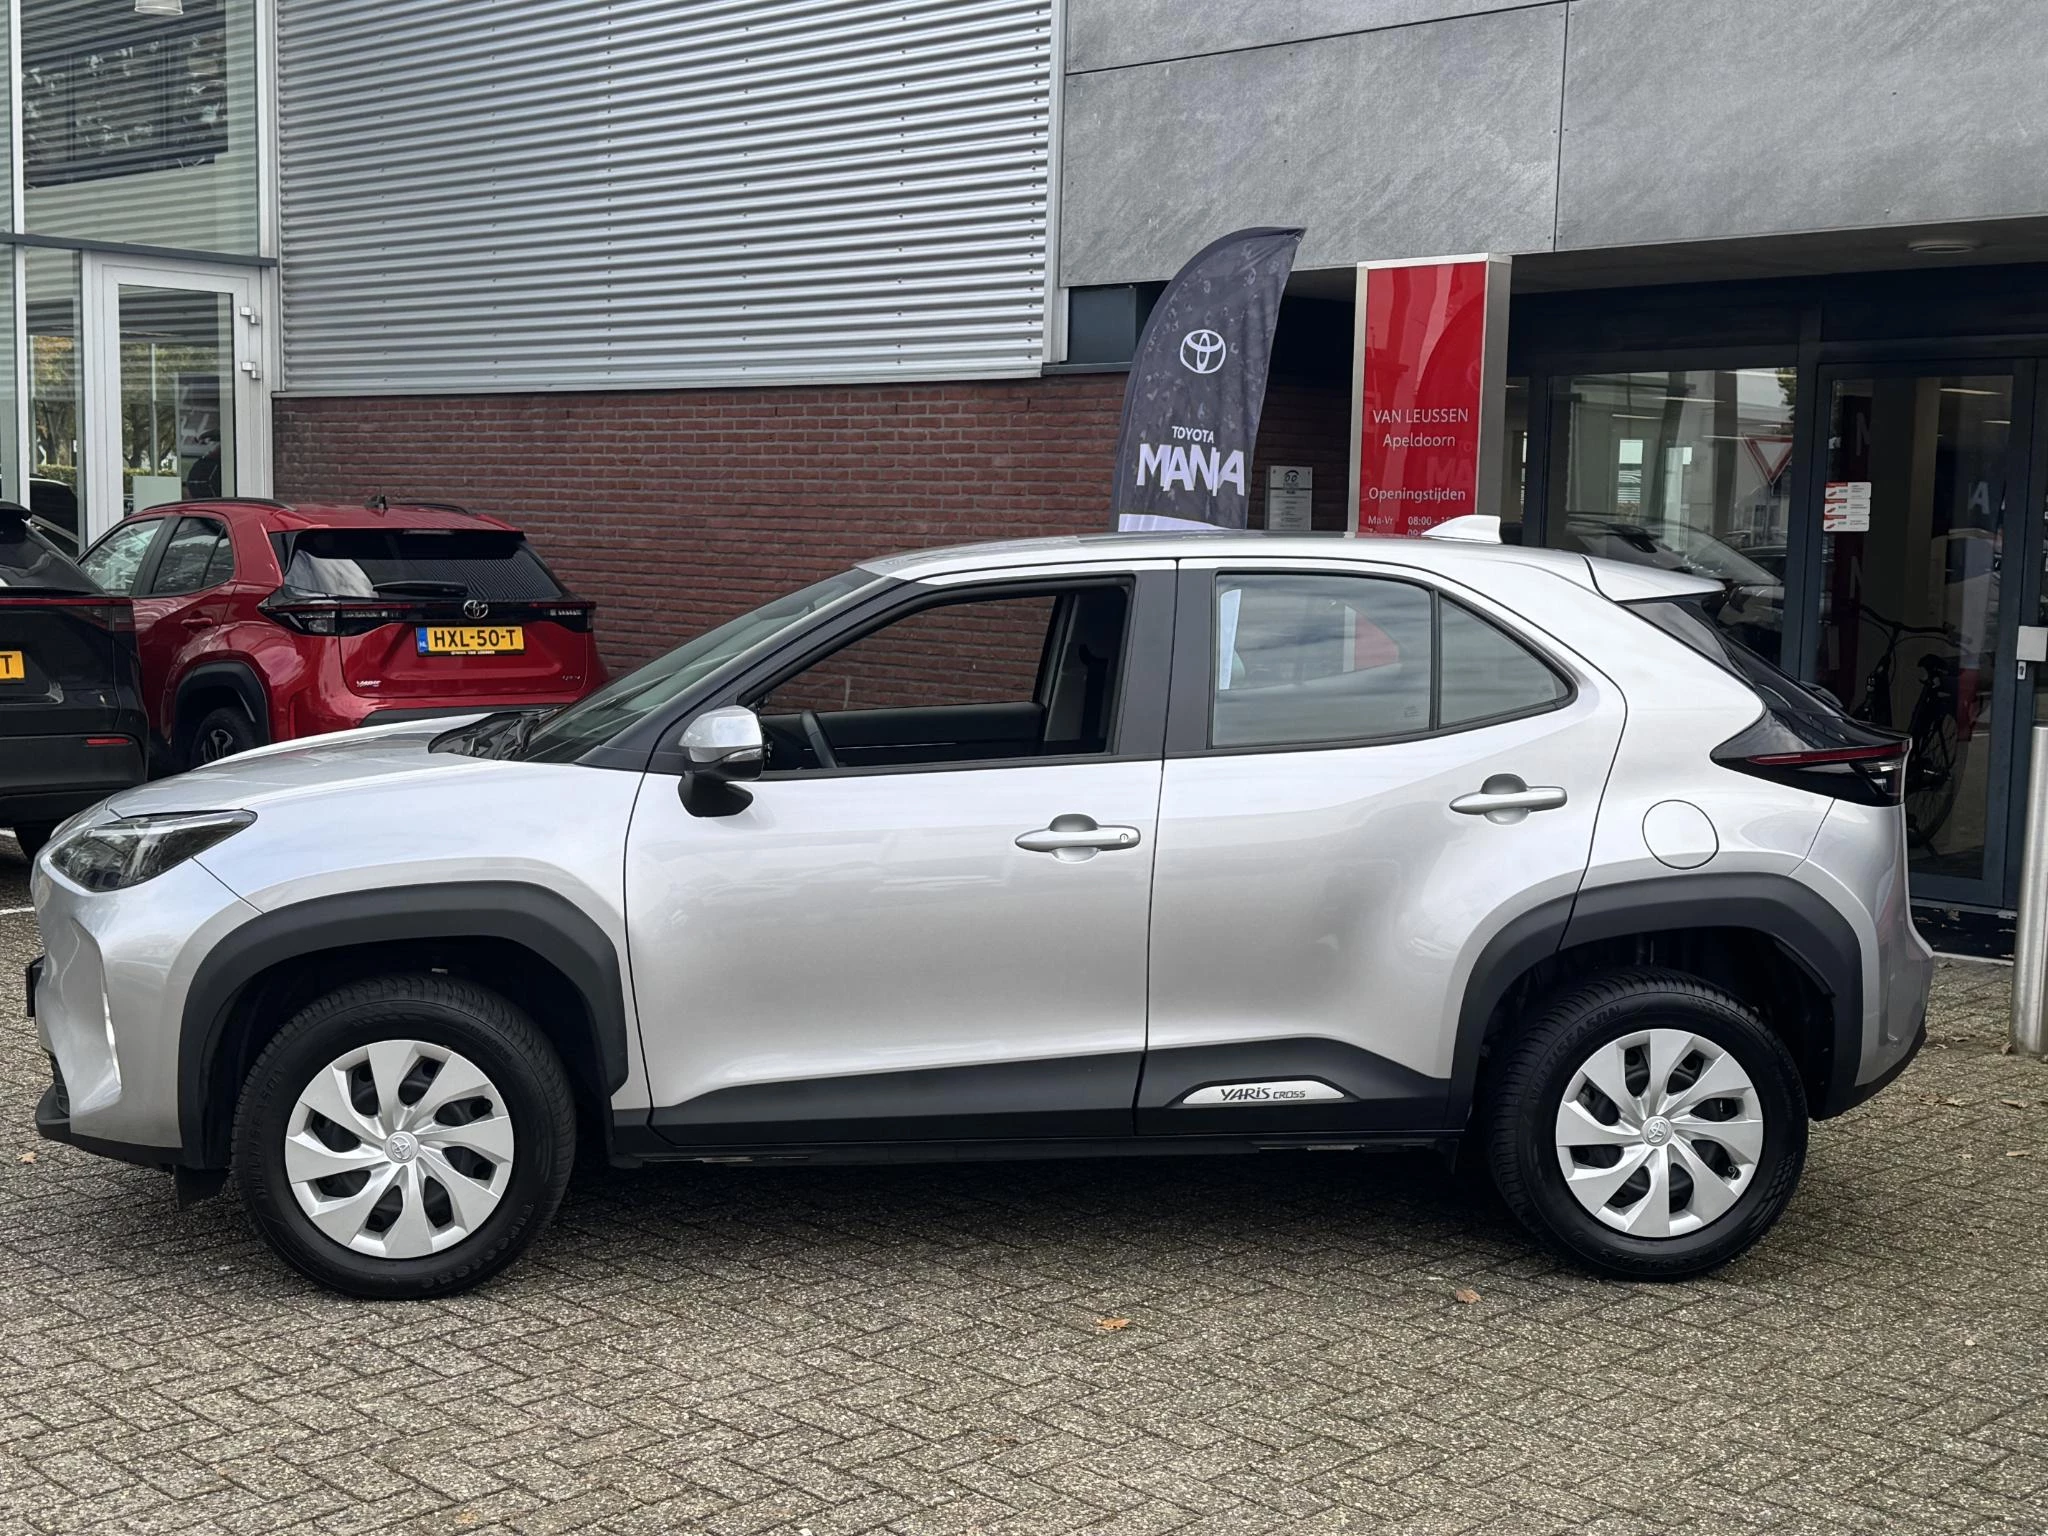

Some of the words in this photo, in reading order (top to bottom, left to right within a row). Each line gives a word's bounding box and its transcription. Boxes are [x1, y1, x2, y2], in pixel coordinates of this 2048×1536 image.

[1373, 409, 1402, 423] VAN
[1406, 408, 1469, 423] LEUSSEN
[1171, 425, 1215, 443] TOYOTA
[1383, 432, 1456, 451] Apeldoorn
[1137, 443, 1245, 496] MANIA
[1368, 486, 1466, 504] Openingstijden
[1407, 515, 1432, 526] 08:00
[433, 629, 516, 648] HXL-50-T
[1273, 1090, 1306, 1100] CROSS
